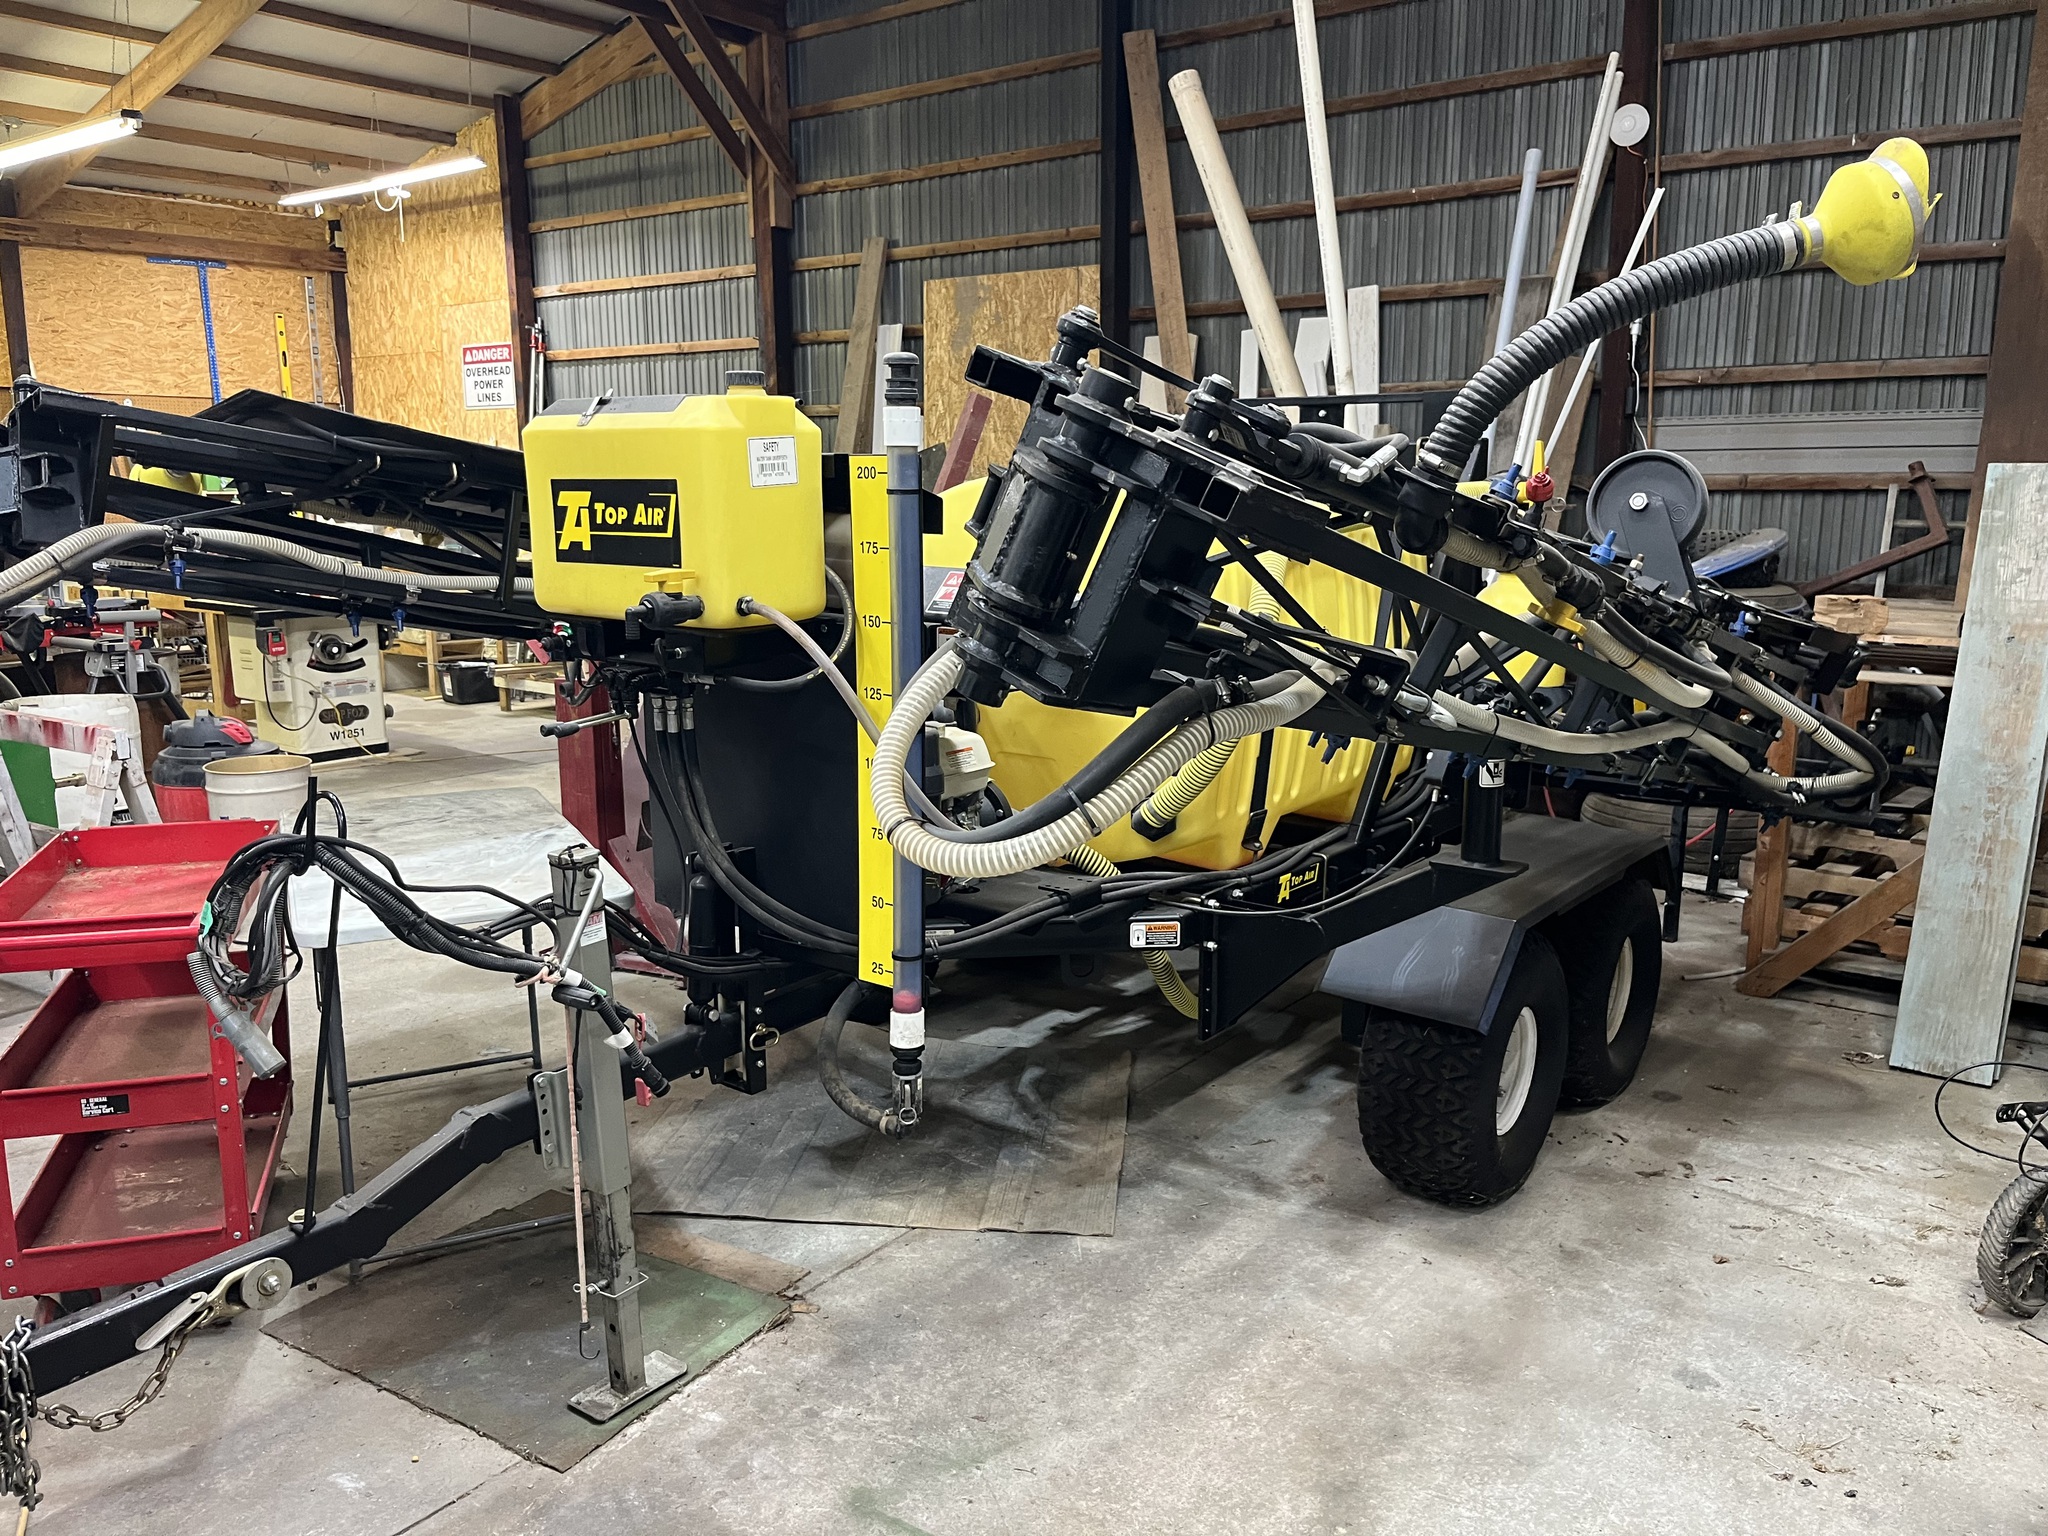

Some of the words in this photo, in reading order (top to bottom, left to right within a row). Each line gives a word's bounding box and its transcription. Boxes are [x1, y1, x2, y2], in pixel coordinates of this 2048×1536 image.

[472, 347, 510, 361] DANGER
[465, 366, 511, 377] OVERHEAD
[474, 379, 504, 390] POWER
[477, 392, 502, 402] LINES
[763, 441, 779, 452] SAFETY
[857, 466, 877, 479] 200
[860, 541, 879, 555] 175
[862, 615, 881, 628] 150
[864, 686, 882, 701] 125
[347, 708, 365, 719] FOX
[330, 727, 365, 741] W1851
[871, 827, 884, 841] 75
[872, 895, 884, 909] 50
[872, 962, 884, 975] 25
